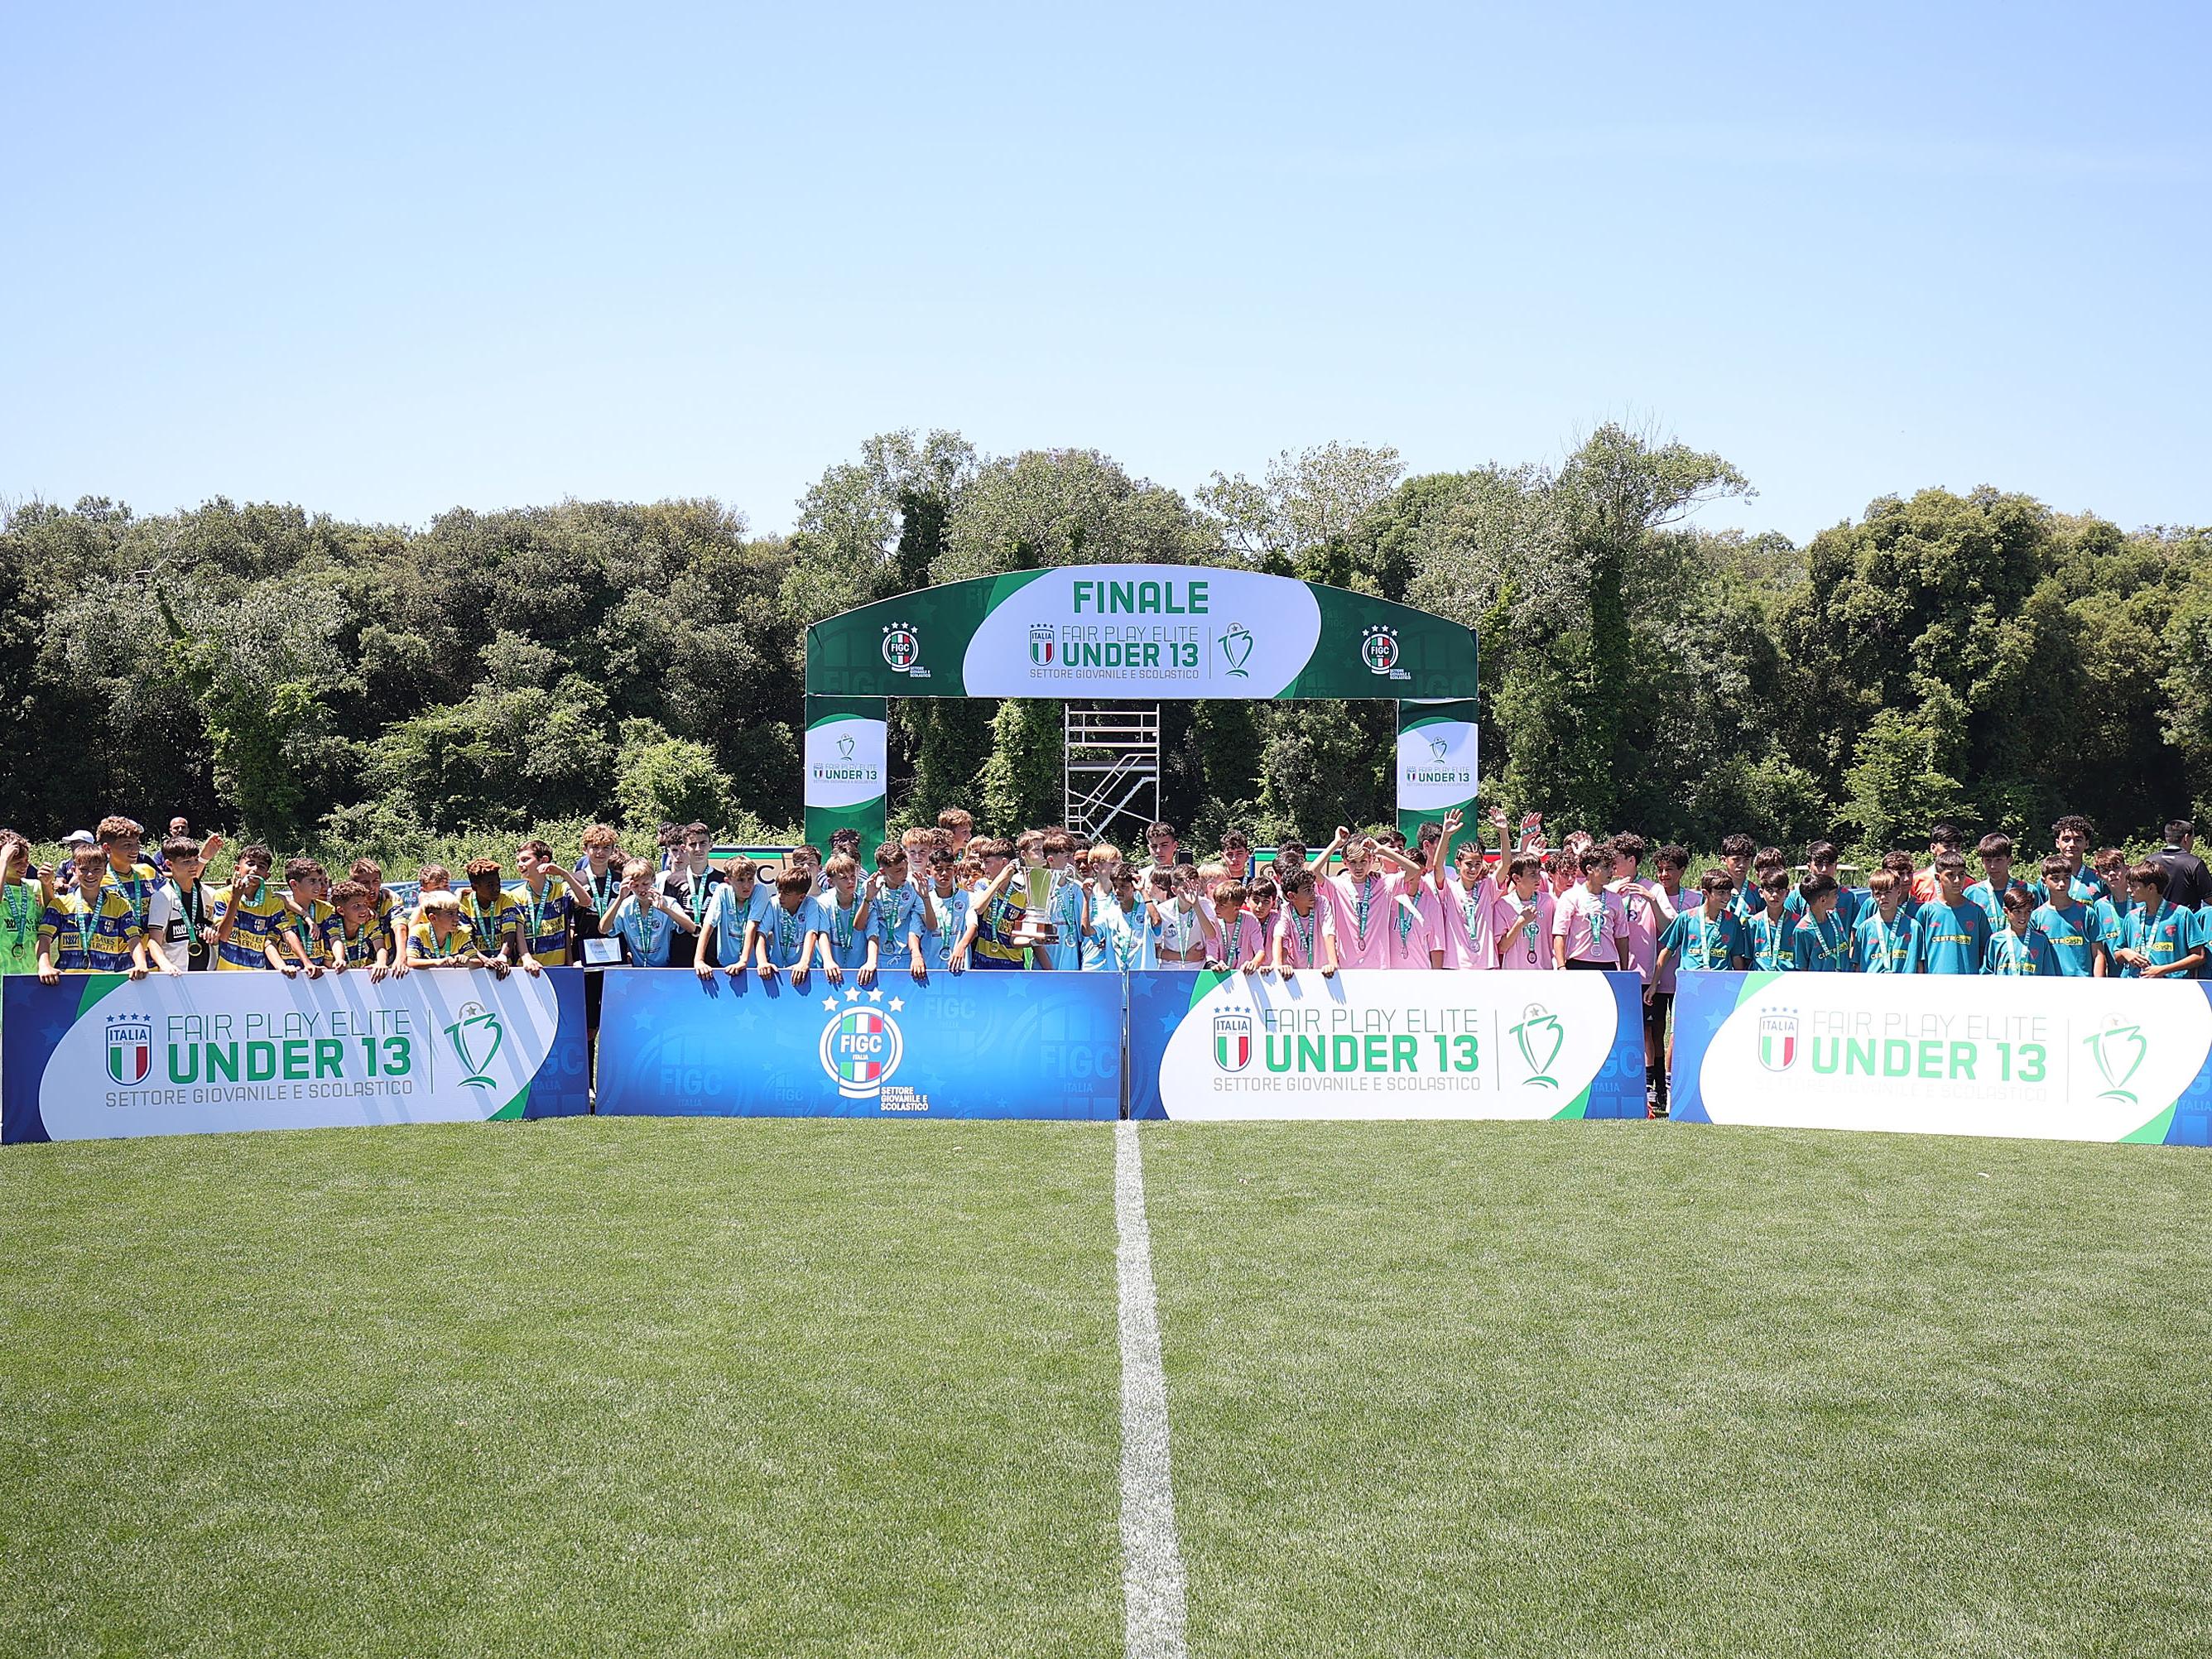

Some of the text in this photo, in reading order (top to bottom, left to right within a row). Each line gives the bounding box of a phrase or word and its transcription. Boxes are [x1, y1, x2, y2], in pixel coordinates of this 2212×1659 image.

[1074, 581, 1209, 614] FINALE
[1062, 625, 1199, 642] FAIR PLAY ELITE
[891, 643, 910, 652] FIGC
[1062, 642, 1199, 667] UNDER 13
[1371, 646, 1390, 655] FIGC
[1030, 669, 1199, 679] SETTORE GIOVANILE E SCOLASTICO
[825, 770, 878, 780] UNDER 13
[1418, 772, 1470, 782] UNDER 13
[1229, 939, 1237, 953] 2024
[2152, 942, 2174, 951] Cash
[167, 1009, 411, 1041] FAIR PLAY ELITE
[1216, 1020, 1248, 1031] ITALIA
[1265, 1008, 1479, 1033] FAIR PLAY ELITE
[1762, 1020, 1795, 1031] ITALIA
[1813, 1010, 2047, 1041] FAIR PLAY ELITE
[109, 1029, 147, 1041] ITALIA
[839, 1035, 882, 1053] FIGC
[168, 1036, 411, 1084] UNDER 13
[1266, 1035, 1479, 1072] UNDER 13
[1811, 1036, 2046, 1083] UNDER 13
[659, 1068, 723, 1096] FIGC
[1214, 1076, 1480, 1092] SETTORE GIOVANILE E SCOLASTICO
[105, 1080, 412, 1108] SETTORE GIOVANILE E SCOLASTICO
[880, 1086, 914, 1095] SETTORE
[880, 1094, 921, 1104] GIOVANILE
[880, 1103, 929, 1112] SCOLASTICO
